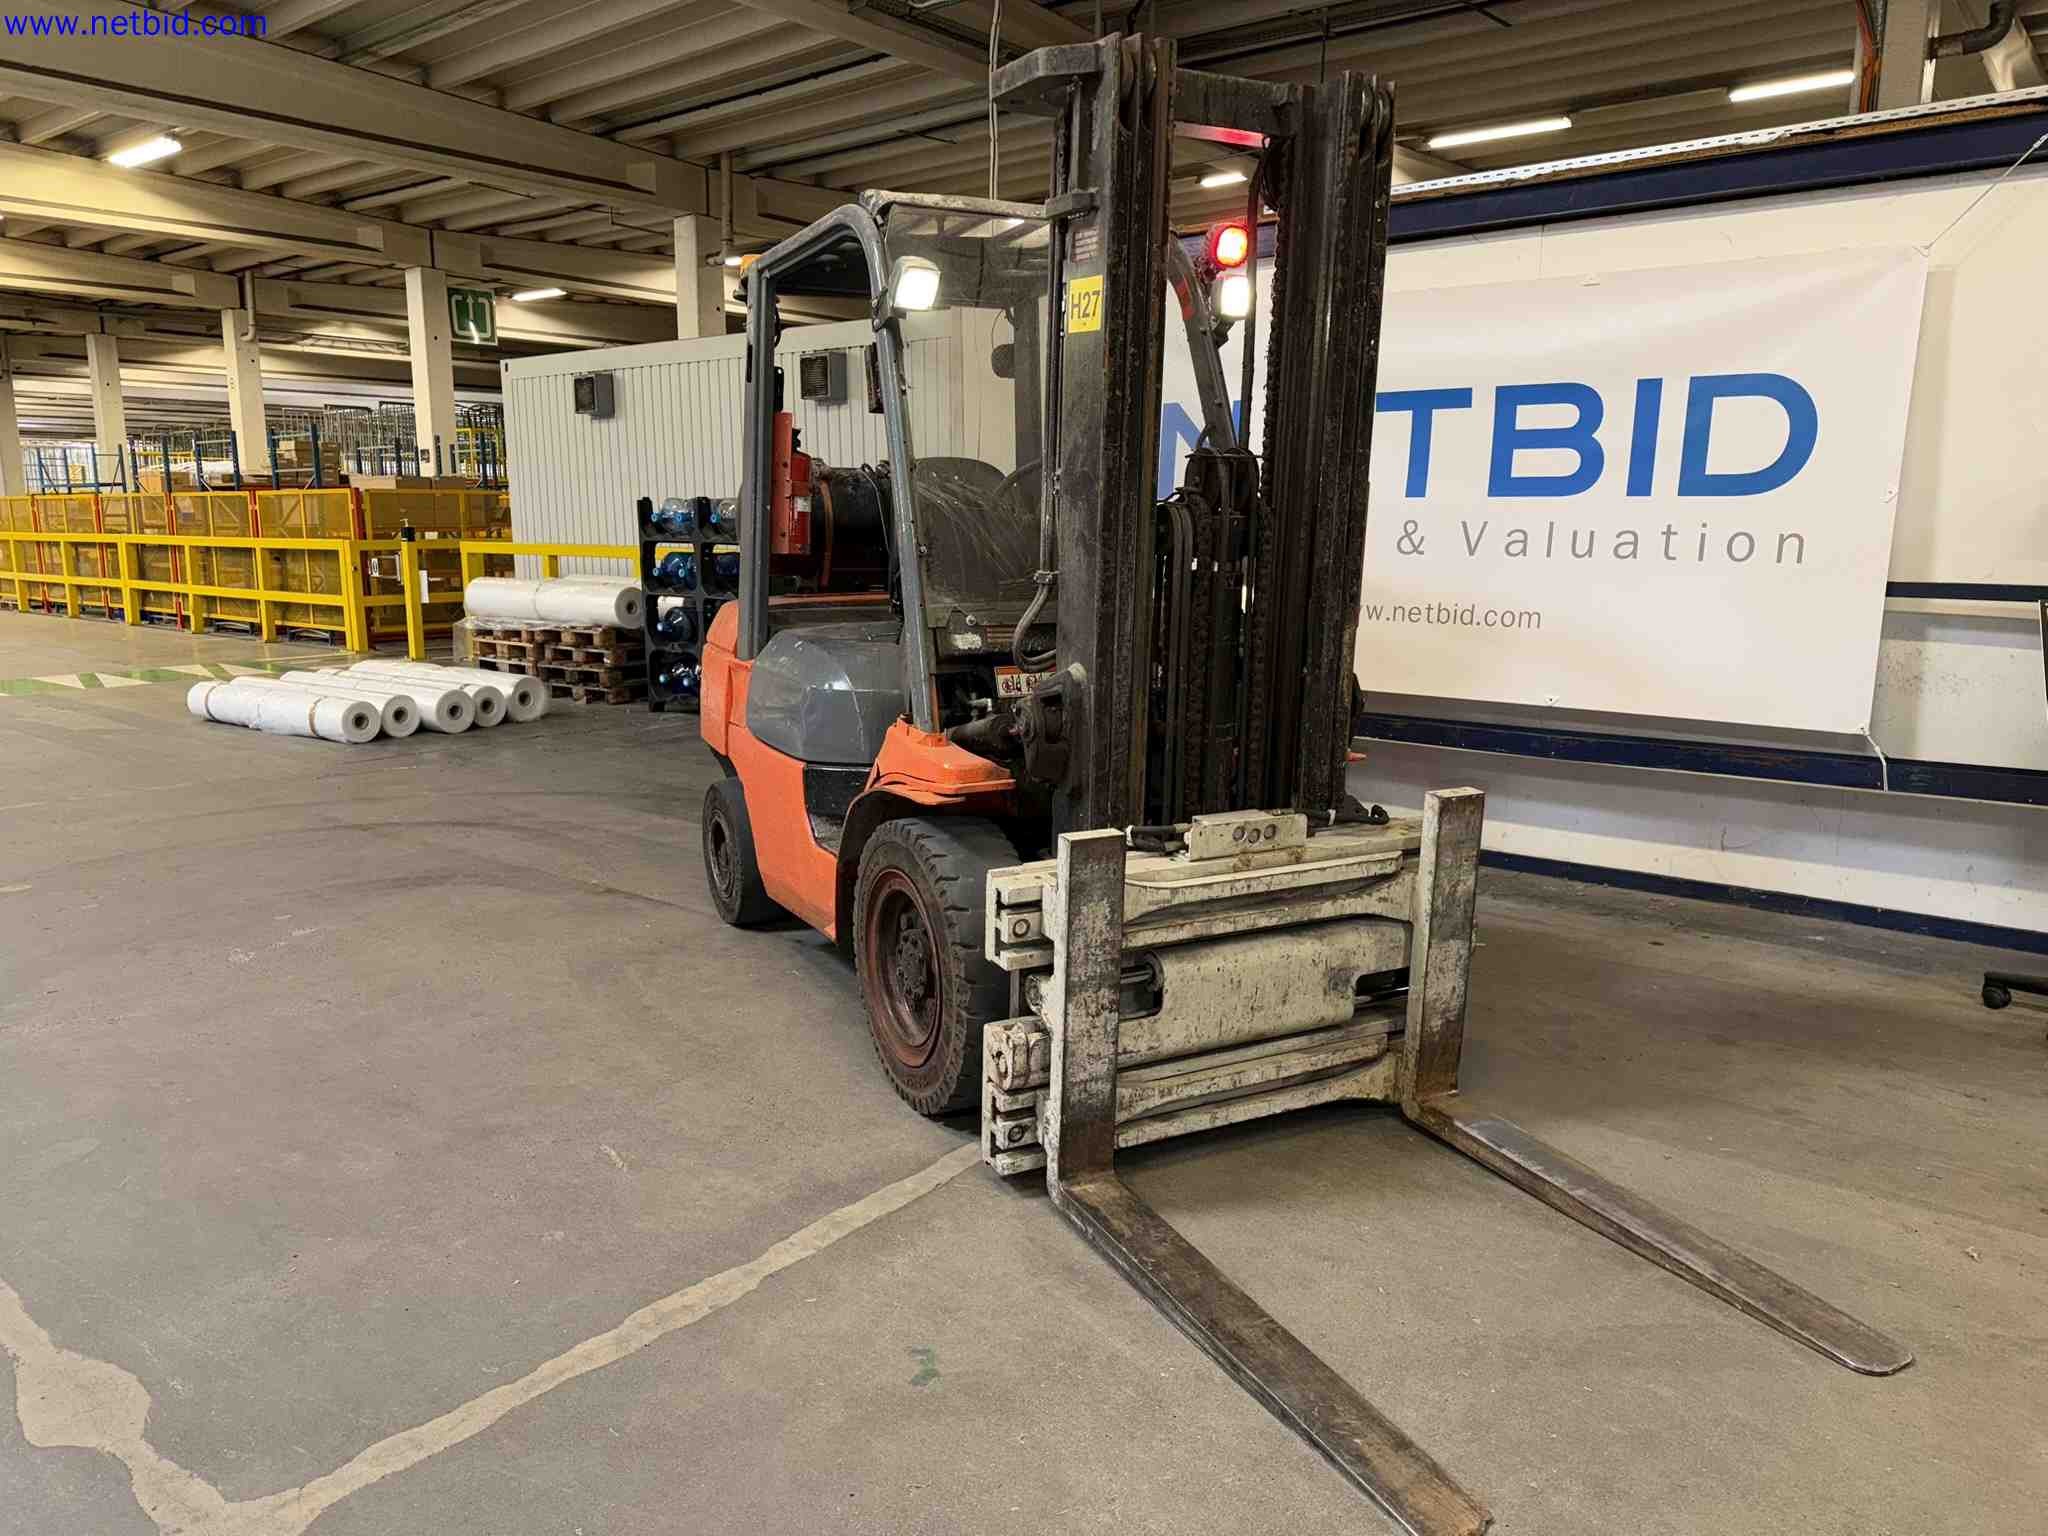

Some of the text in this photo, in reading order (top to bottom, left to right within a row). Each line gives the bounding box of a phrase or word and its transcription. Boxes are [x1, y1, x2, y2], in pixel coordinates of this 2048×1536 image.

[1071, 290, 1101, 320] H27
[1157, 372, 1818, 500] NTBID
[1396, 519, 1805, 564] & Valuation
